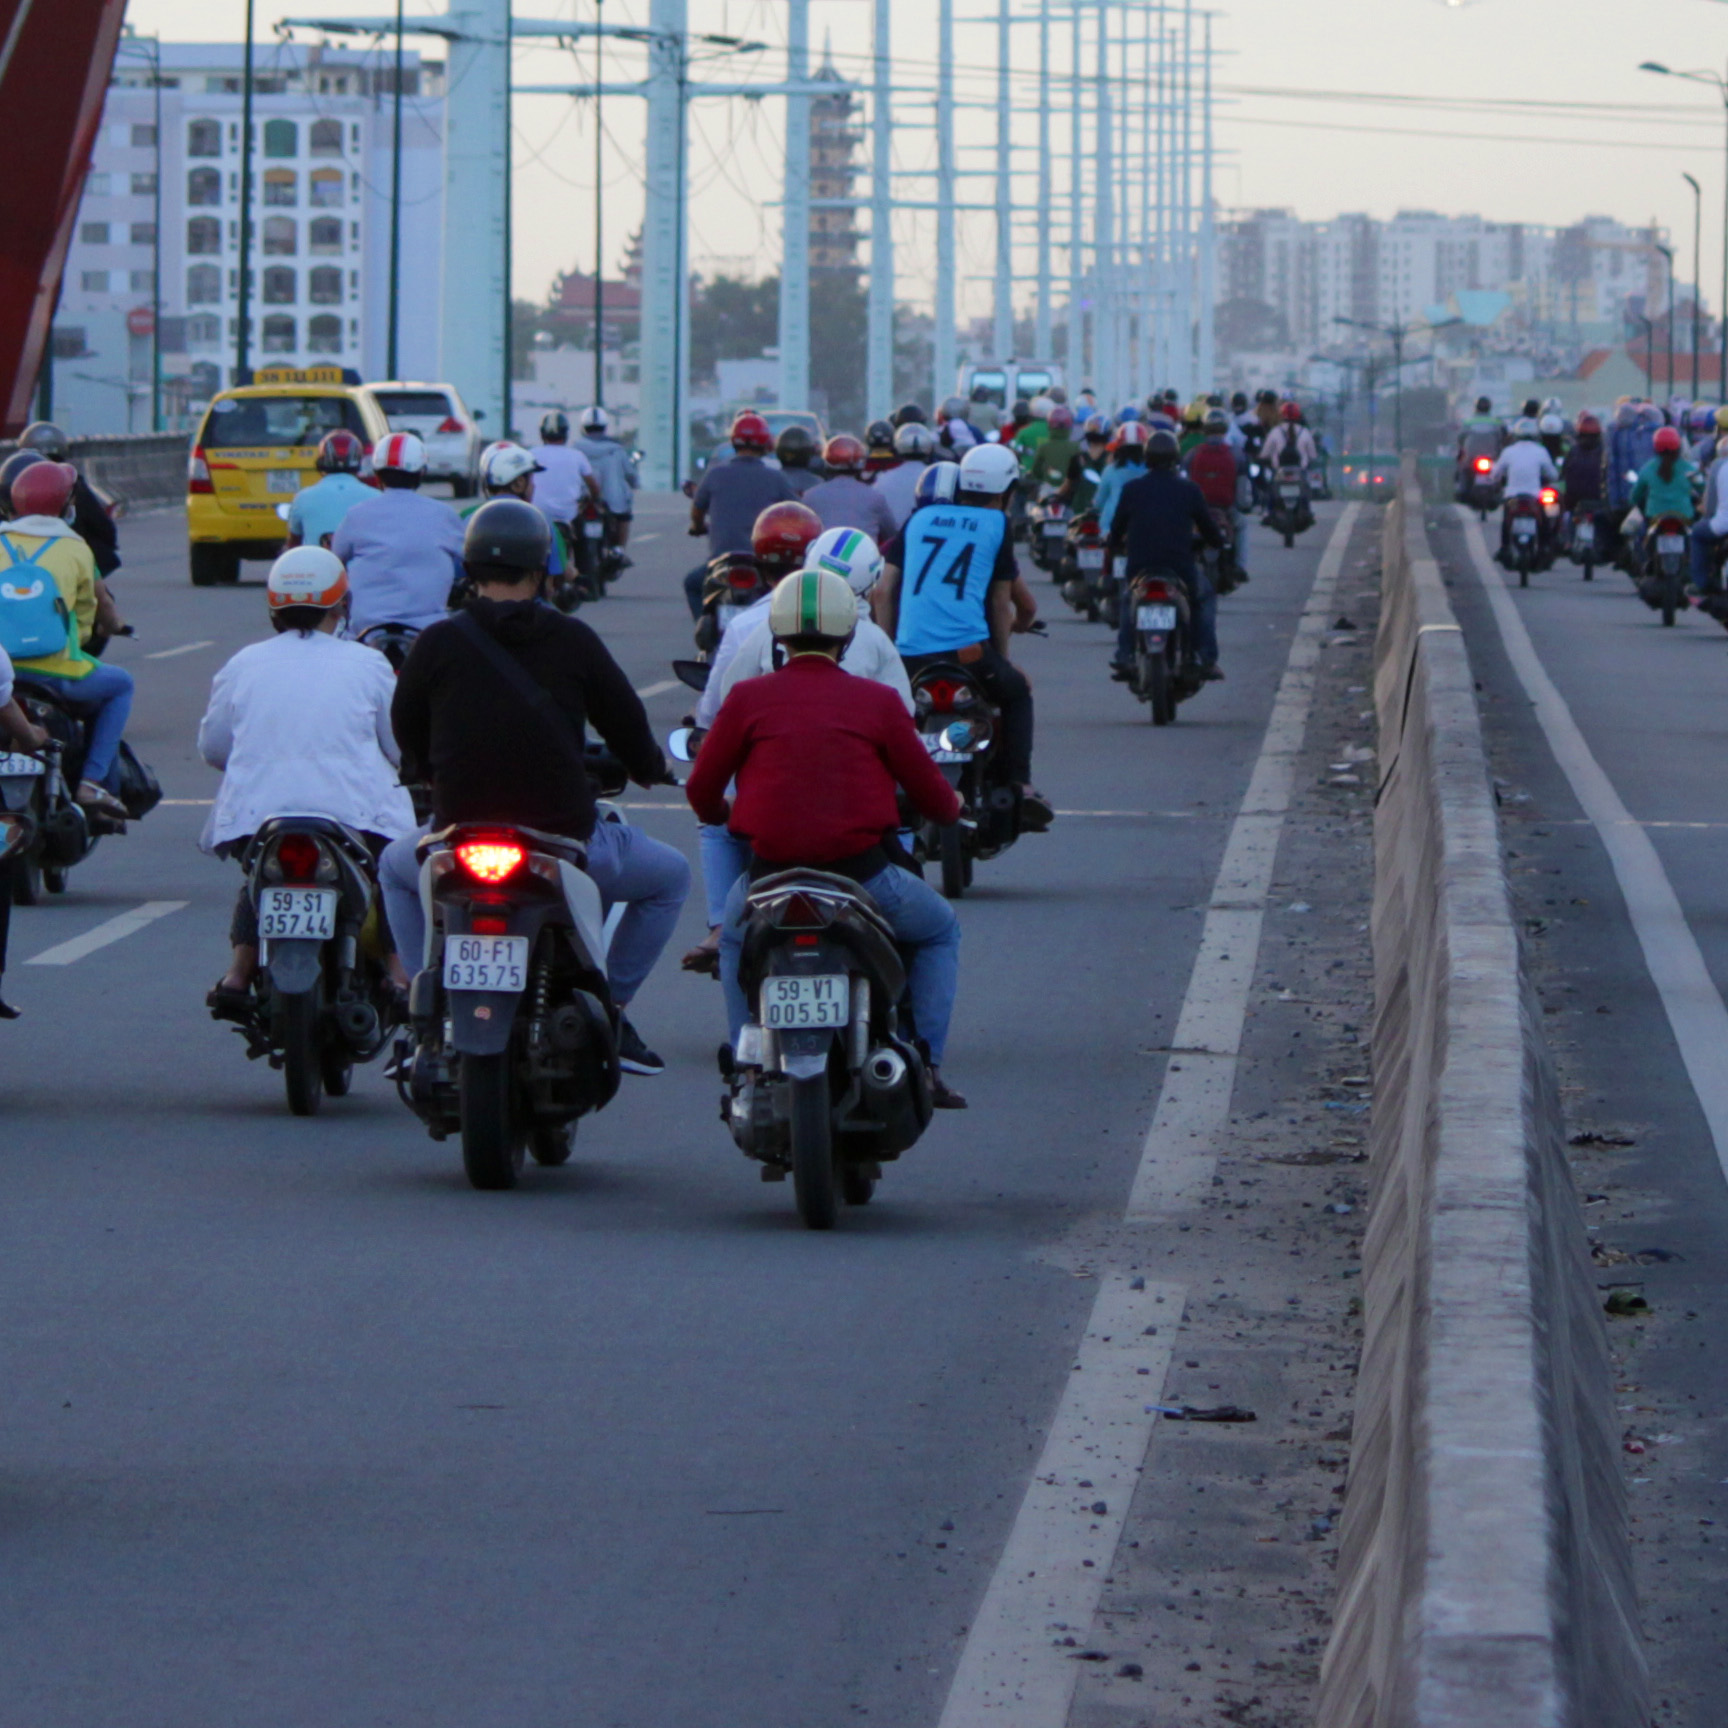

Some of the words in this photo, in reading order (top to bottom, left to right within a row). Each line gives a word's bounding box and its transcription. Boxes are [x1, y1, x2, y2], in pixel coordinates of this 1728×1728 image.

[314, 370, 335, 383] 111
[930, 515, 955, 528] Anh
[912, 536, 977, 601] 74
[272, 892, 323, 912] 59-S1
[264, 914, 329, 936] 357.44
[459, 940, 513, 963] 60-F1
[449, 964, 520, 988] 635.75
[777, 979, 833, 1001] 59-V1
[770, 1002, 840, 1024] 005.51
